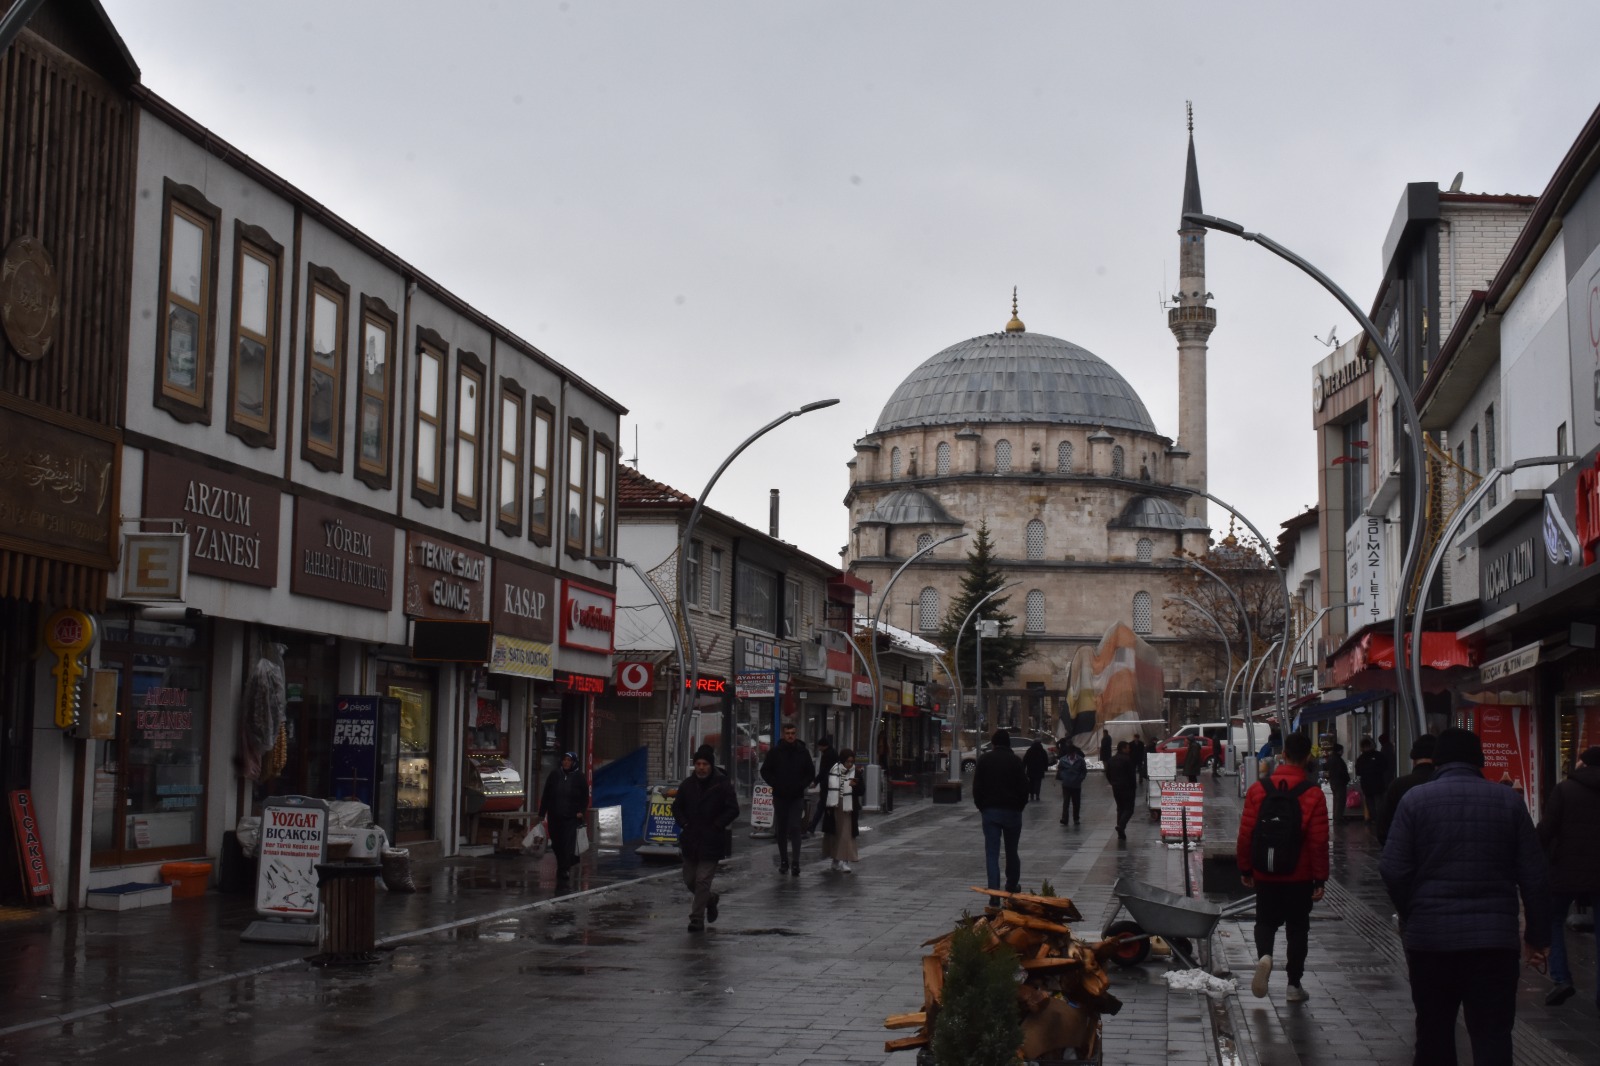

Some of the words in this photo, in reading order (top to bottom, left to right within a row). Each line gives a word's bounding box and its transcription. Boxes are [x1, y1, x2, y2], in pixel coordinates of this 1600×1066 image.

[184, 480, 251, 527] ARZUM
[325, 518, 372, 559] YÖREM
[1367, 518, 1380, 567] SOLMAZ
[305, 549, 341, 580] BAHARAT
[341, 561, 348, 583] &
[347, 560, 388, 597] KURUYEMİŞ
[457, 552, 484, 581] SAAT
[1485, 552, 1511, 604] KOÇAK
[1511, 537, 1535, 587] ALTIN
[433, 577, 470, 613] GÜMÜŞ
[504, 583, 546, 620] KASAP
[54, 624, 83, 640] KALE
[1503, 655, 1522, 674] ALTIN
[61, 653, 69, 724] ANAHTARCI
[145, 686, 188, 706] ARZUM
[137, 708, 192, 729] ECZANESİ
[350, 703, 372, 712] pepsi
[348, 736, 375, 746] YANA
[271, 811, 318, 828] YOZGAT
[650, 803, 673, 816] KAS
[266, 828, 321, 843] BIÇAKÇISI
